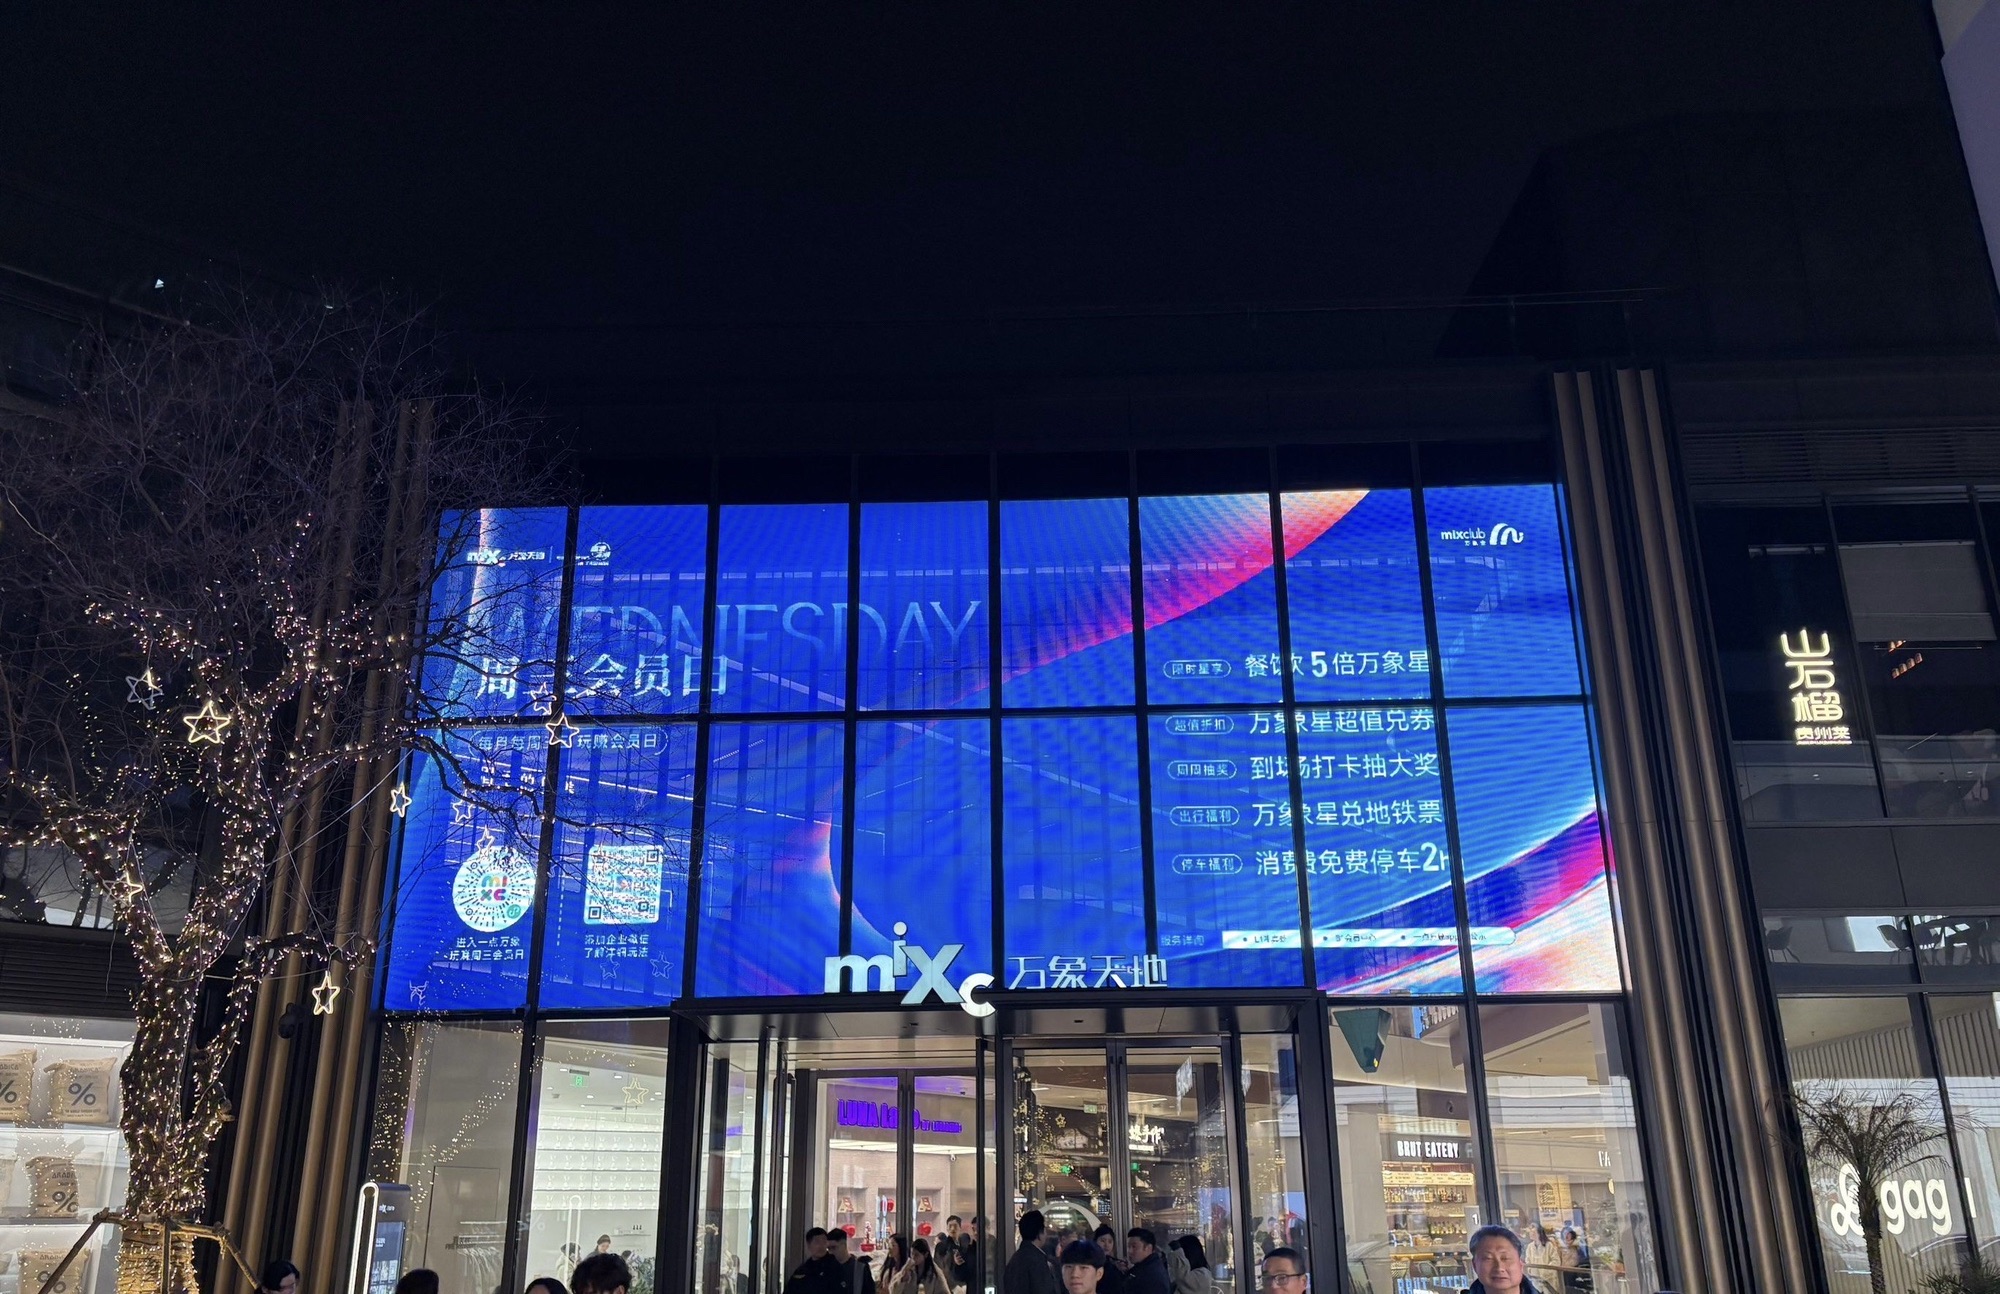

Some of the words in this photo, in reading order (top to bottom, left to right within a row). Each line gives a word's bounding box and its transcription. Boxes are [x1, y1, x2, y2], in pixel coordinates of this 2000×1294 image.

[1441, 527, 1486, 540] mixclub
[475, 653, 729, 698] 周三会员日
[1250, 753, 1440, 780] 到场打卡抽大奖
[1179, 808, 1232, 823] 出行福利
[1252, 800, 1443, 827] 万象星兑地铁票
[1181, 858, 1235, 871] 停车福利
[1008, 954, 1168, 989] 万象天地
[1397, 1140, 1422, 1157] BRUT
[1424, 1141, 1460, 1158] EATERY
